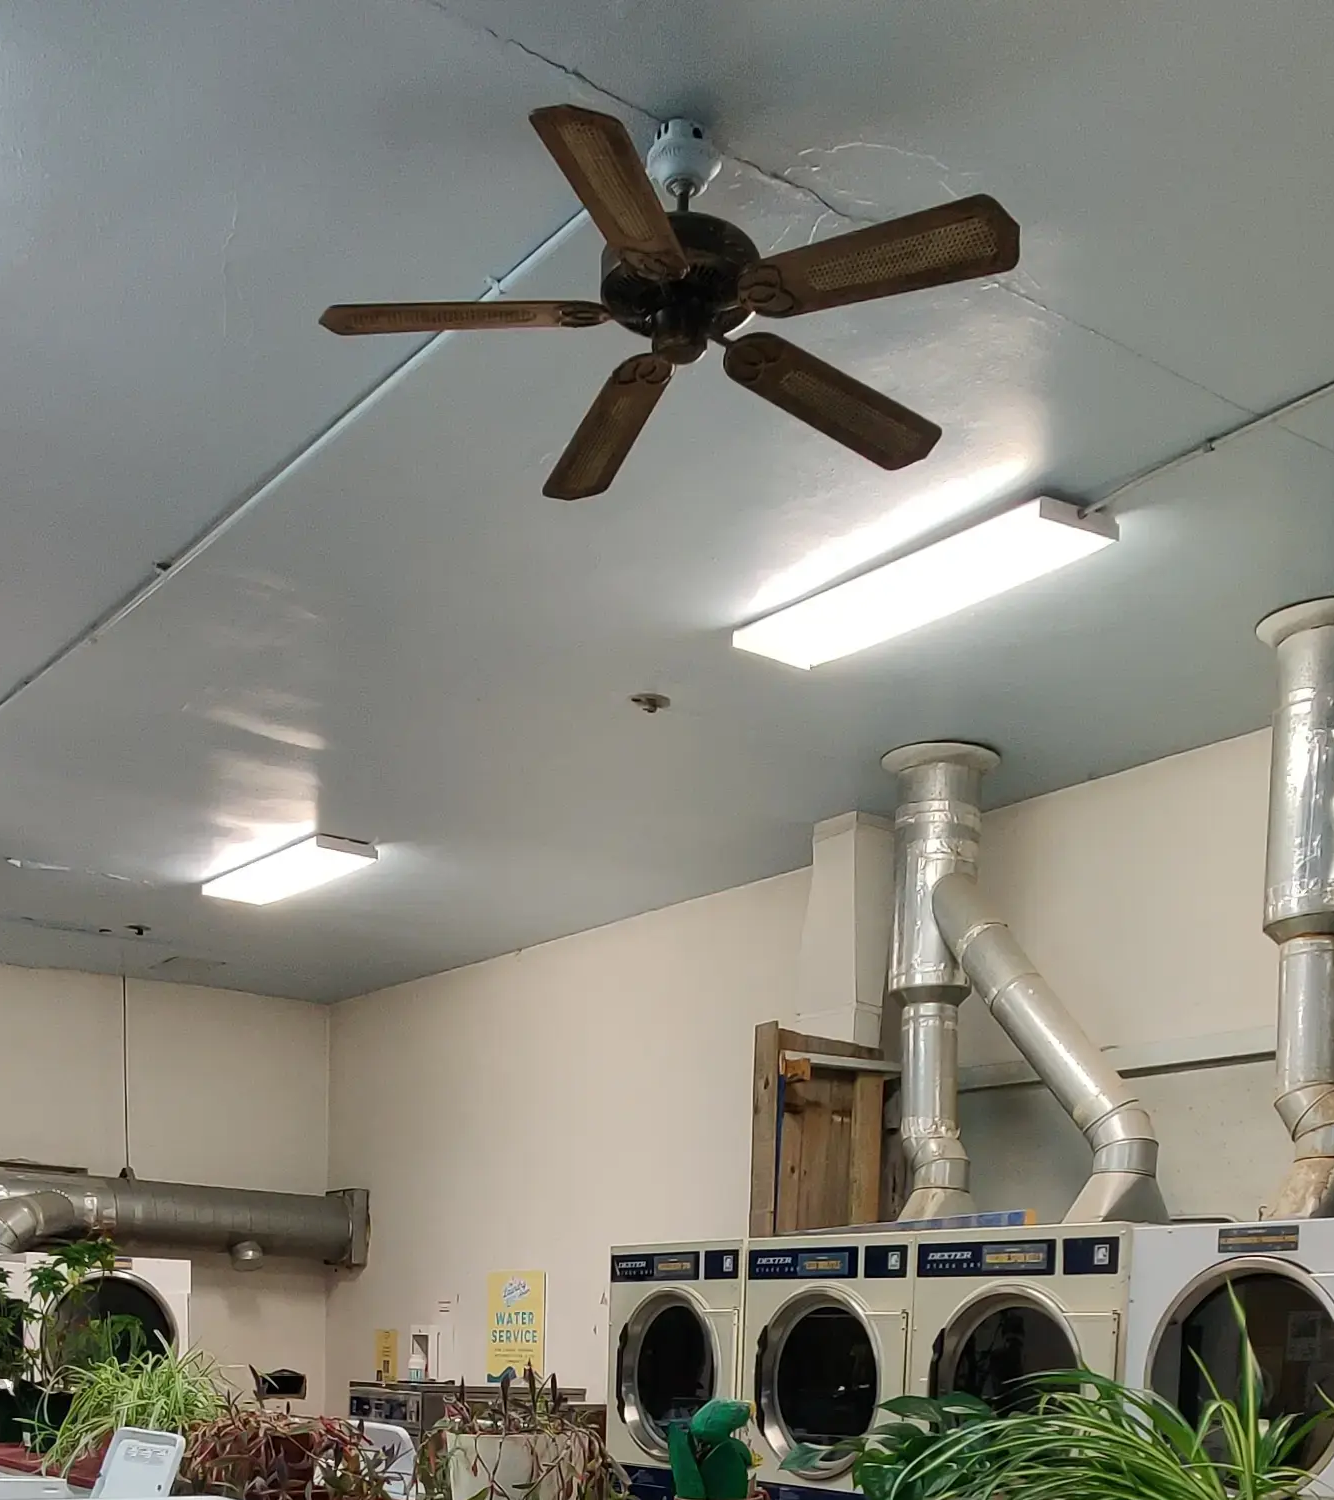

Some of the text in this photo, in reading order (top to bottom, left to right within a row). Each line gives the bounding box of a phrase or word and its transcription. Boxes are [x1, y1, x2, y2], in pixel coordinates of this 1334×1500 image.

[756, 1257, 792, 1265] DEXTER
[927, 1252, 972, 1260] DEXTER
[495, 1311, 535, 1326] WATER
[491, 1329, 538, 1343] SERVICE
